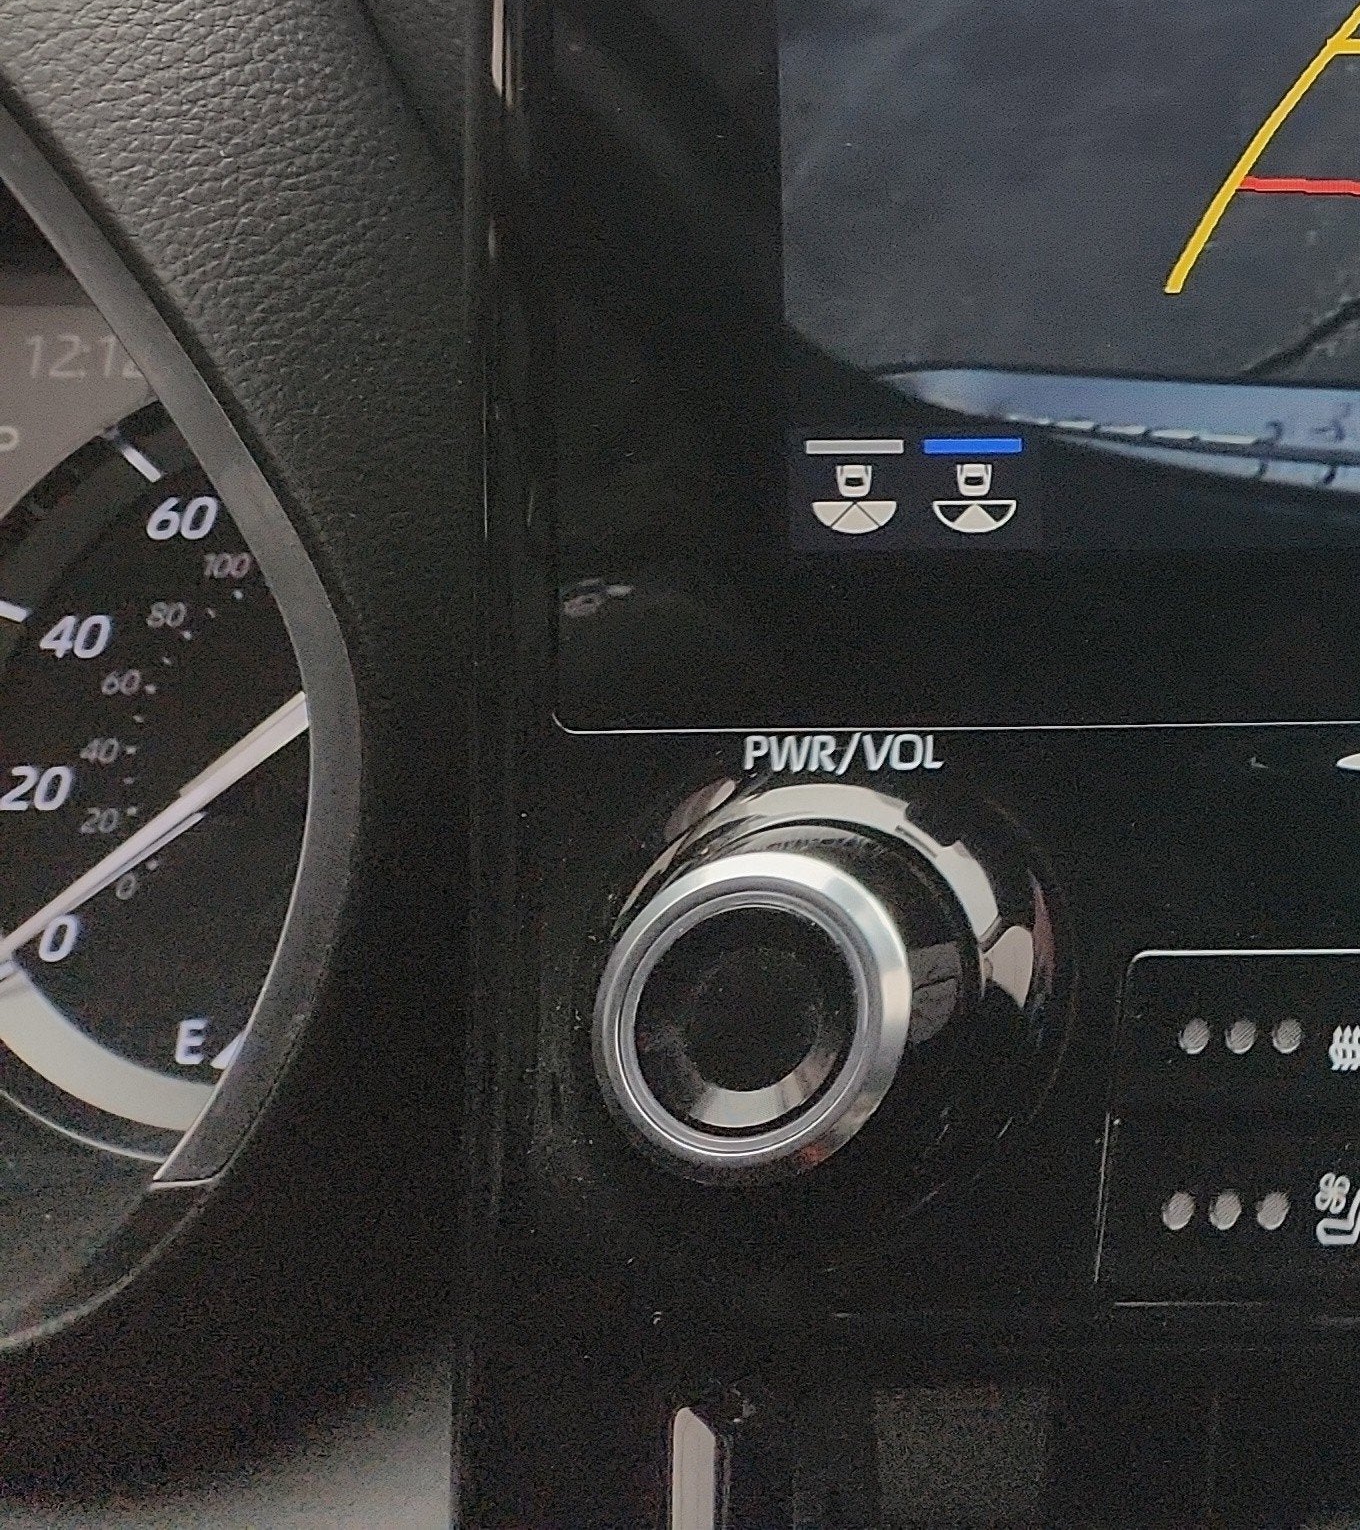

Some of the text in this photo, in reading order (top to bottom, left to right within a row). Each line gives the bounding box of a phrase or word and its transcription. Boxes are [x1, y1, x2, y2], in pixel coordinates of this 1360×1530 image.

[146, 496, 219, 541] 60
[204, 552, 250, 579] 100
[147, 601, 187, 628] 80
[39, 614, 112, 659] 40
[101, 669, 142, 696] 60
[80, 737, 120, 764] 40
[744, 732, 945, 775] PWR/VOL
[0, 765, 73, 811] 20
[80, 807, 120, 834] 20
[38, 913, 79, 963] 0
[175, 1018, 208, 1065] E
